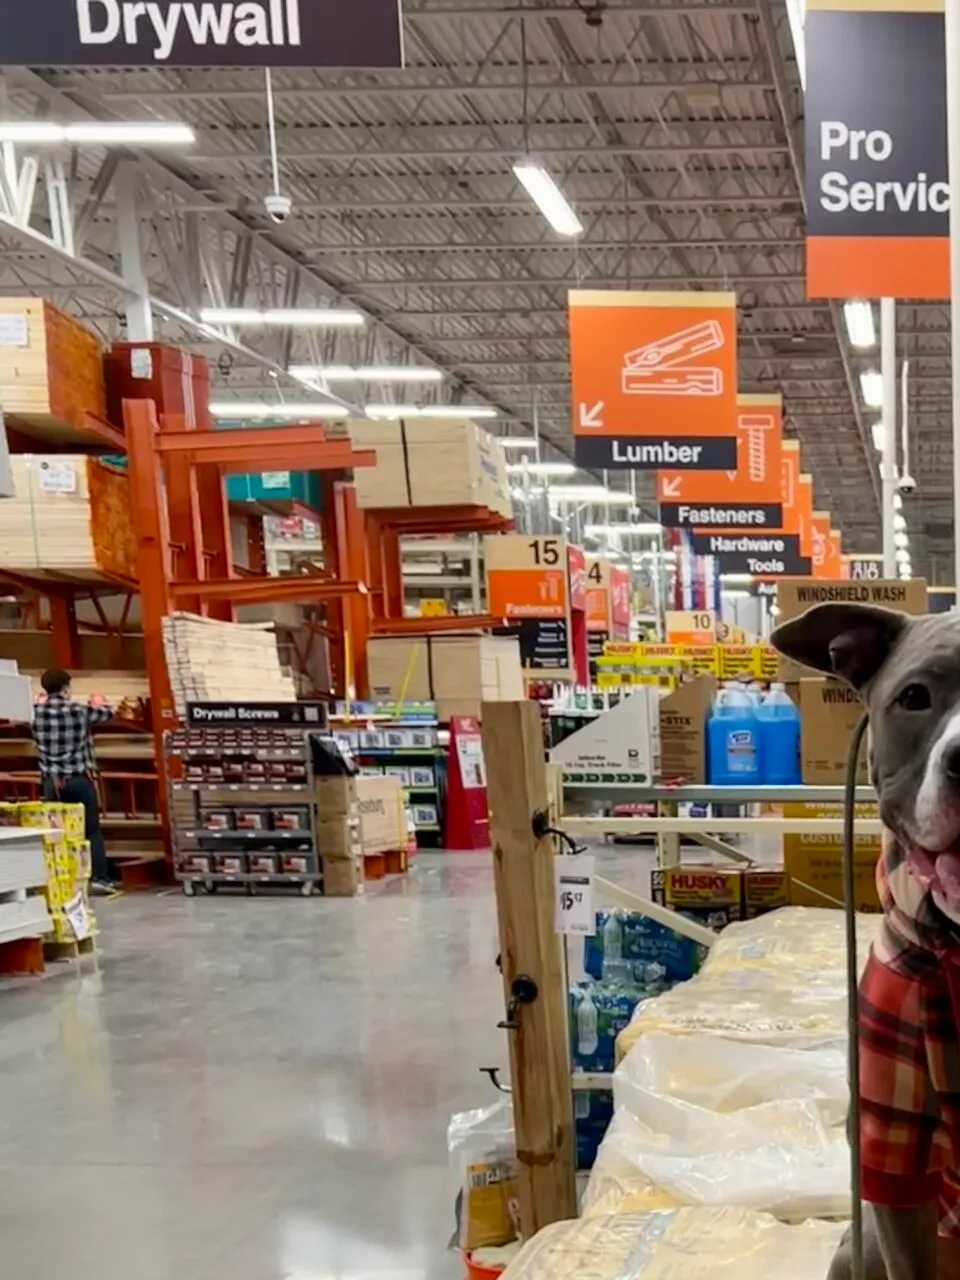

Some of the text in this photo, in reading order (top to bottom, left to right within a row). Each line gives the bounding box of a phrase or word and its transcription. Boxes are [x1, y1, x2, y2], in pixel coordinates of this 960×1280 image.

[77, 0, 301, 59] Drywall
[820, 121, 892, 161] Pro
[612, 440, 702, 463] Lumber
[678, 506, 766, 524] Fasteners
[528, 540, 560, 565] 15
[710, 536, 785, 552] Hardware
[587, 562, 602, 584] 4
[747, 558, 785, 572] Tools
[797, 586, 906, 601] WINDSHIELD WASH
[692, 614, 710, 630] 10
[193, 707, 279, 720] Drywall Screws
[671, 874, 727, 889] HUSKY
